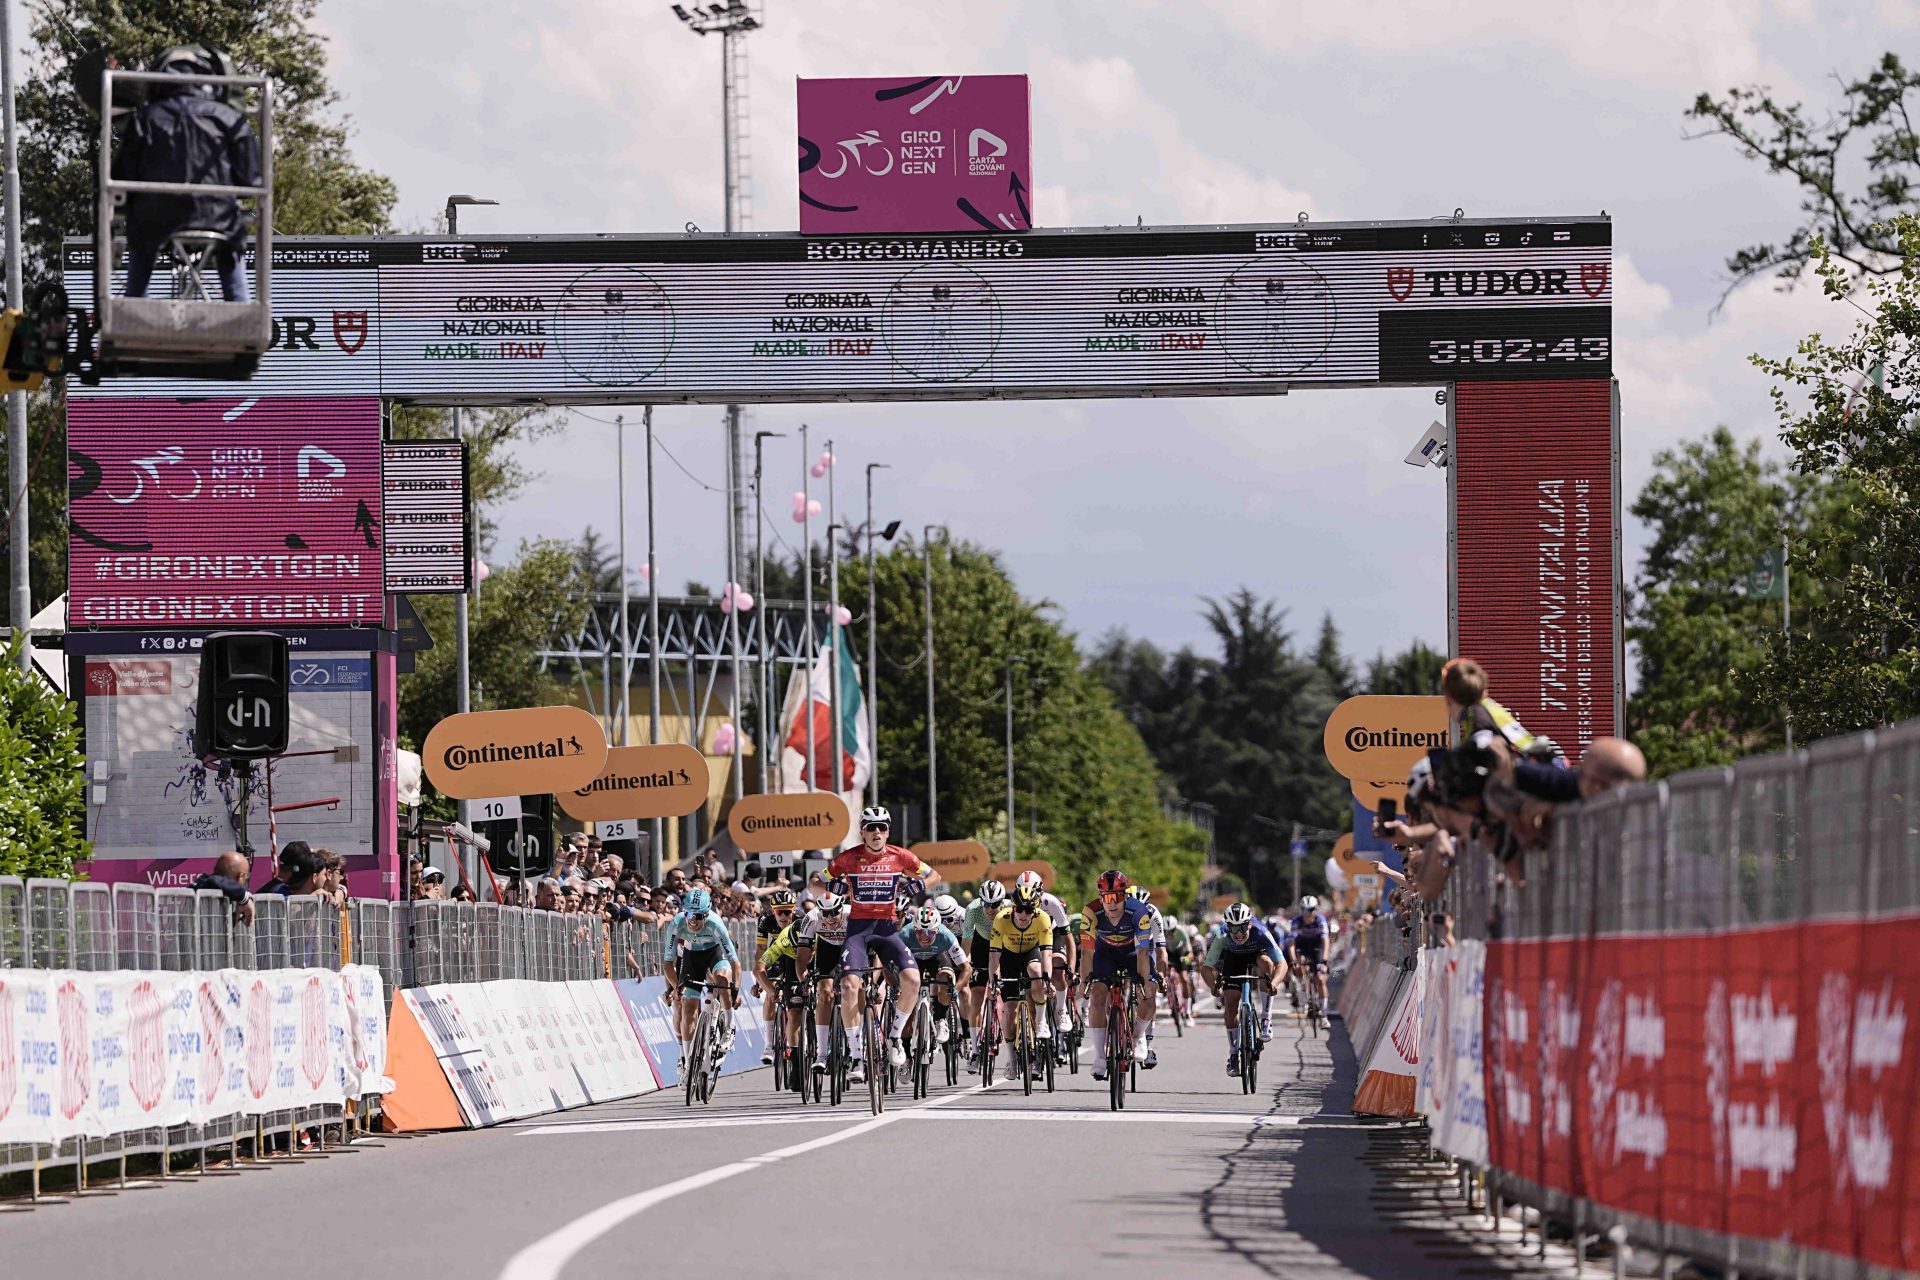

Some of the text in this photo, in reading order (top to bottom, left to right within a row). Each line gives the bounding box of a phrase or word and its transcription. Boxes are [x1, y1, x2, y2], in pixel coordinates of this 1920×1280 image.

[901, 130, 942, 143] GIRO
[901, 146, 946, 159] NEXT
[901, 162, 937, 174] GEN
[807, 240, 1024, 260] BORGOMANERO
[1425, 268, 1571, 297] TUDOR
[786, 293, 873, 309] GIORNATA
[1117, 287, 1206, 304] GIORNATA
[457, 297, 545, 312] GIORNATA
[772, 316, 874, 332] NAZIONALE
[1104, 311, 1206, 327] NAZIONALE
[444, 320, 546, 335] NAZIONALE
[1429, 337, 1609, 364] 3:02:43
[211, 447, 262, 462] GIRO
[401, 450, 446, 459] TUDOR
[211, 465, 267, 479] NEXT
[211, 483, 256, 497] GEN
[298, 488, 343, 497] GIOVANI
[400, 481, 447, 490] TUDOR
[400, 513, 448, 523] TUDOR
[1575, 479, 1590, 551] ITALIANE
[401, 545, 449, 554] TUDOR
[95, 555, 360, 580] #GIRONEXTGEN
[401, 577, 450, 586] TUDOR
[1576, 557, 1591, 607] STATO
[1539, 480, 1567, 711] TRENITALIA
[83, 595, 371, 620] GIRONEXTGEN.IT
[1576, 614, 1592, 662] DELLO
[1577, 668, 1593, 744] FERROVIE
[444, 737, 564, 771] Continental
[484, 803, 504, 818] 10
[187, 816, 213, 829] CHASE
[606, 823, 624, 837] 25
[741, 813, 822, 833] Continental
[196, 827, 219, 839] DREAM
[770, 855, 783, 865] 50
